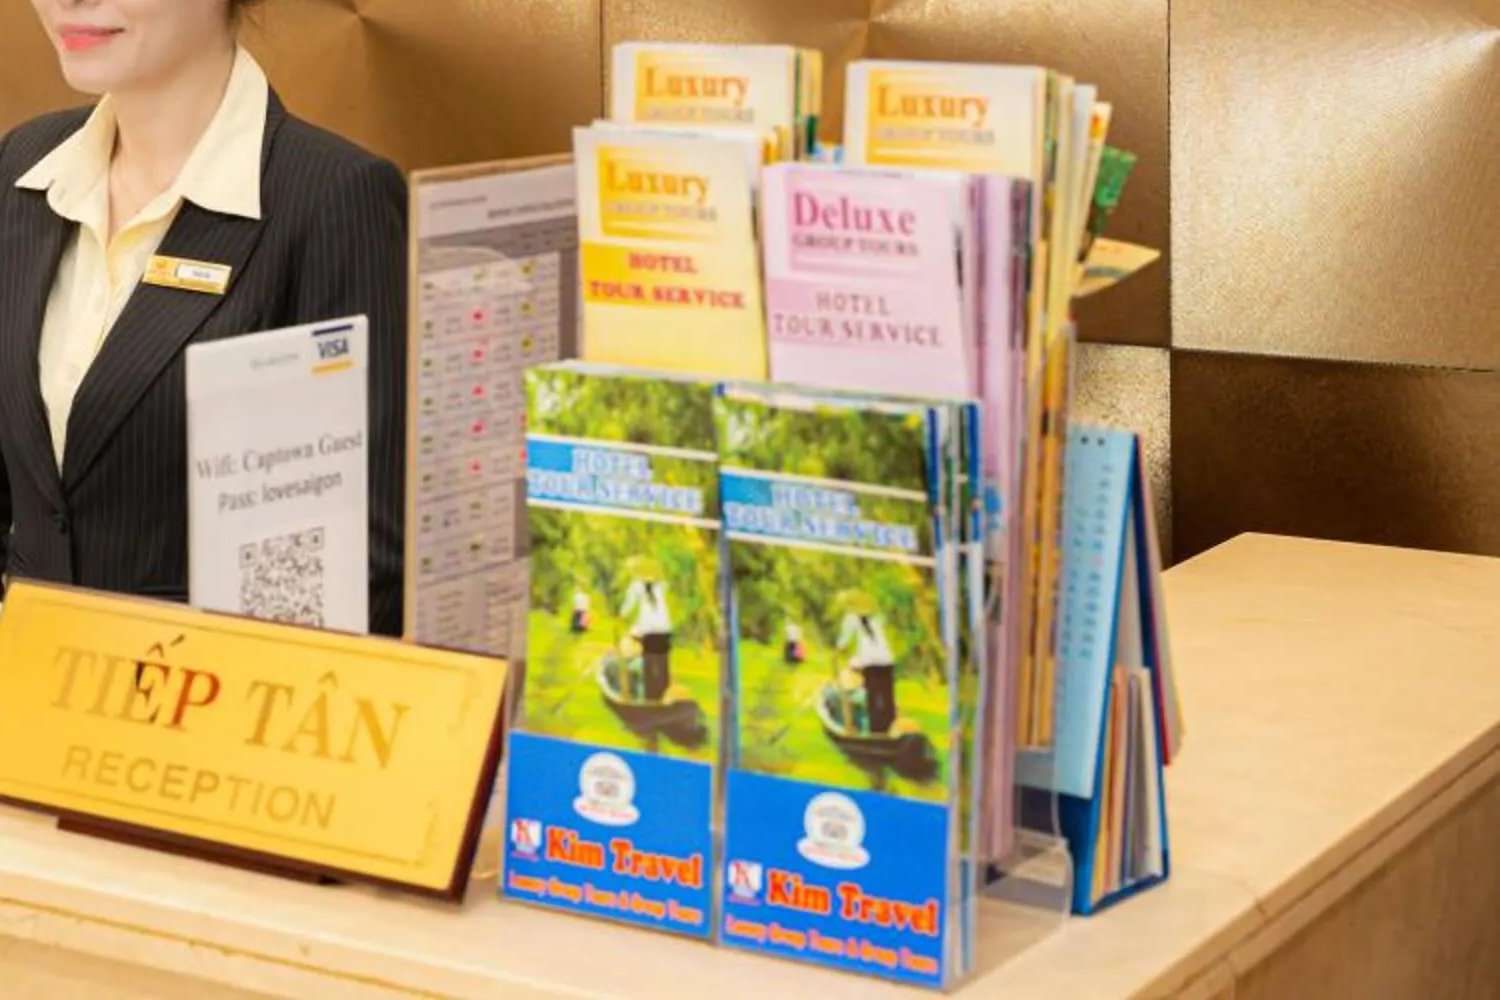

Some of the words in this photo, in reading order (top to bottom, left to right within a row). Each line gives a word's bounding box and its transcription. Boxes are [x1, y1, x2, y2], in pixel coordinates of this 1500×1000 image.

[645, 65, 750, 108] Luxury
[876, 84, 989, 129] Luxury
[605, 160, 710, 203] Luxury
[792, 190, 916, 236] Deluxe
[628, 252, 698, 275] HOTEL
[588, 281, 645, 301] TOUR
[651, 284, 746, 310] SERVICE
[815, 291, 891, 317] HOTEL
[317, 338, 350, 360] VISA
[772, 313, 834, 339] TOUR
[841, 319, 944, 347] SERVICE
[318, 431, 363, 456] Guest
[50, 634, 221, 734] TIẾP
[243, 671, 412, 771] TÂN
[60, 744, 336, 830] RECEPTION
[546, 826, 605, 870] Kim
[610, 837, 703, 888] Travel
[766, 868, 832, 916] Kim
[836, 881, 939, 936] Travel
